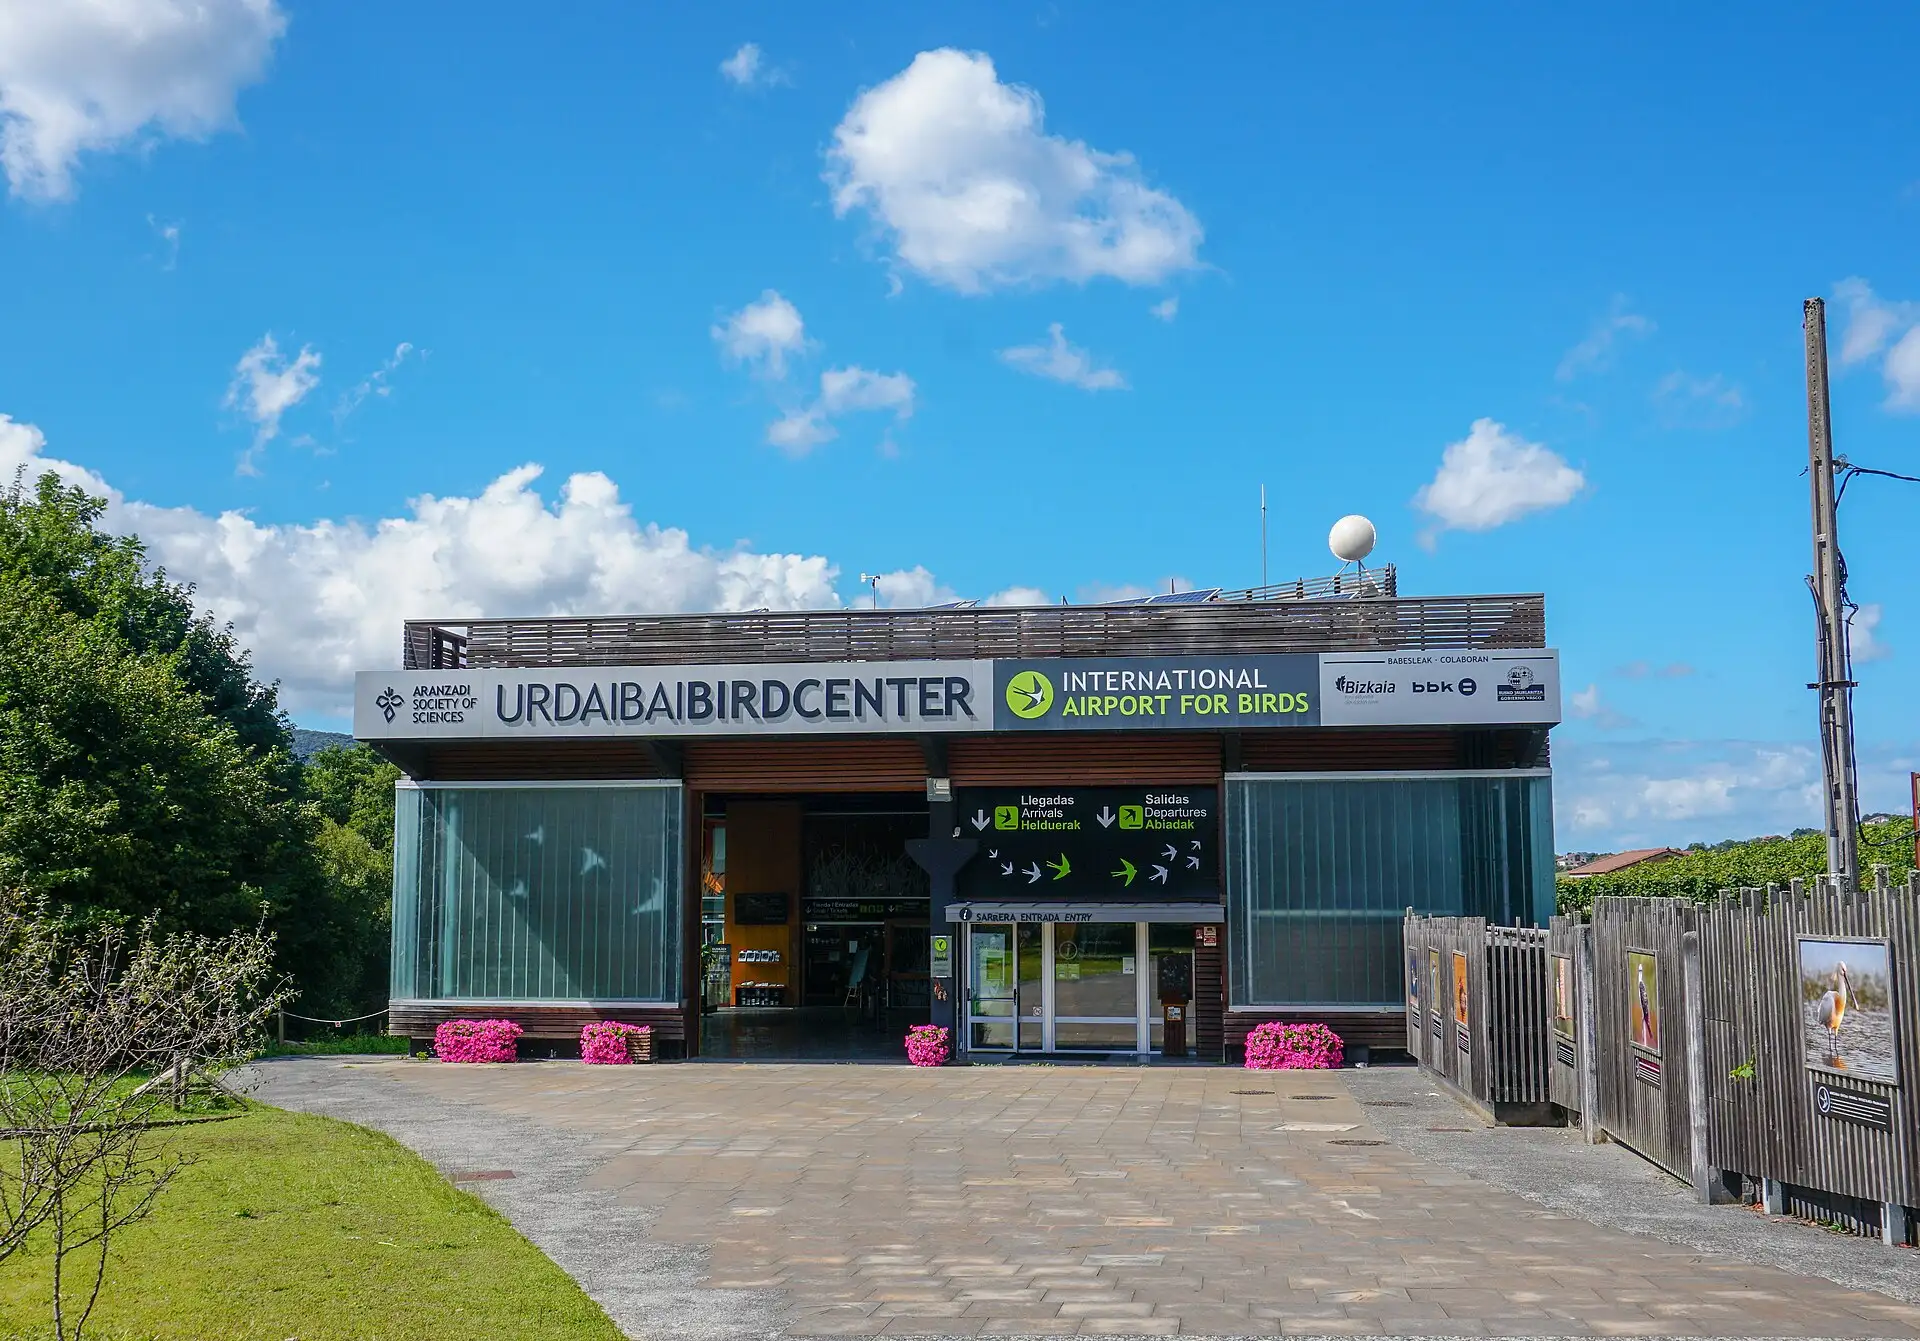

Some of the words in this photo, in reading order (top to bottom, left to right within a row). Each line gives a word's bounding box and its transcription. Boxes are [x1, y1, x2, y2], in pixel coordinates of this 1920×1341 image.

[1387, 656, 1433, 665] BABESLEAK
[1439, 655, 1489, 664] COLABORAN
[1063, 668, 1268, 692] INTERNATIONAL
[412, 684, 471, 697] ARANZADI
[1345, 680, 1396, 694] Bizkaia
[1412, 681, 1454, 693] bbk
[412, 697, 459, 710] SOCIETY
[461, 697, 478, 709] OF
[496, 676, 976, 723] URDAIBAIBIRDCENTER
[1062, 694, 1172, 716] AIRPORT
[1180, 693, 1231, 714] FOR
[1238, 691, 1309, 713] BIRDS
[412, 710, 465, 724] SCIENCES
[1021, 795, 1075, 808] Llegadas
[1145, 794, 1190, 805] Salidas
[1021, 807, 1064, 818] Arrivals
[1144, 807, 1207, 820] Departures
[1021, 819, 1081, 830] Helduerak
[1145, 819, 1195, 830] Abiadak
[976, 912, 1017, 922] SARRERA
[1020, 912, 1060, 922] ENTRADA
[1064, 912, 1093, 922] ENTRY
